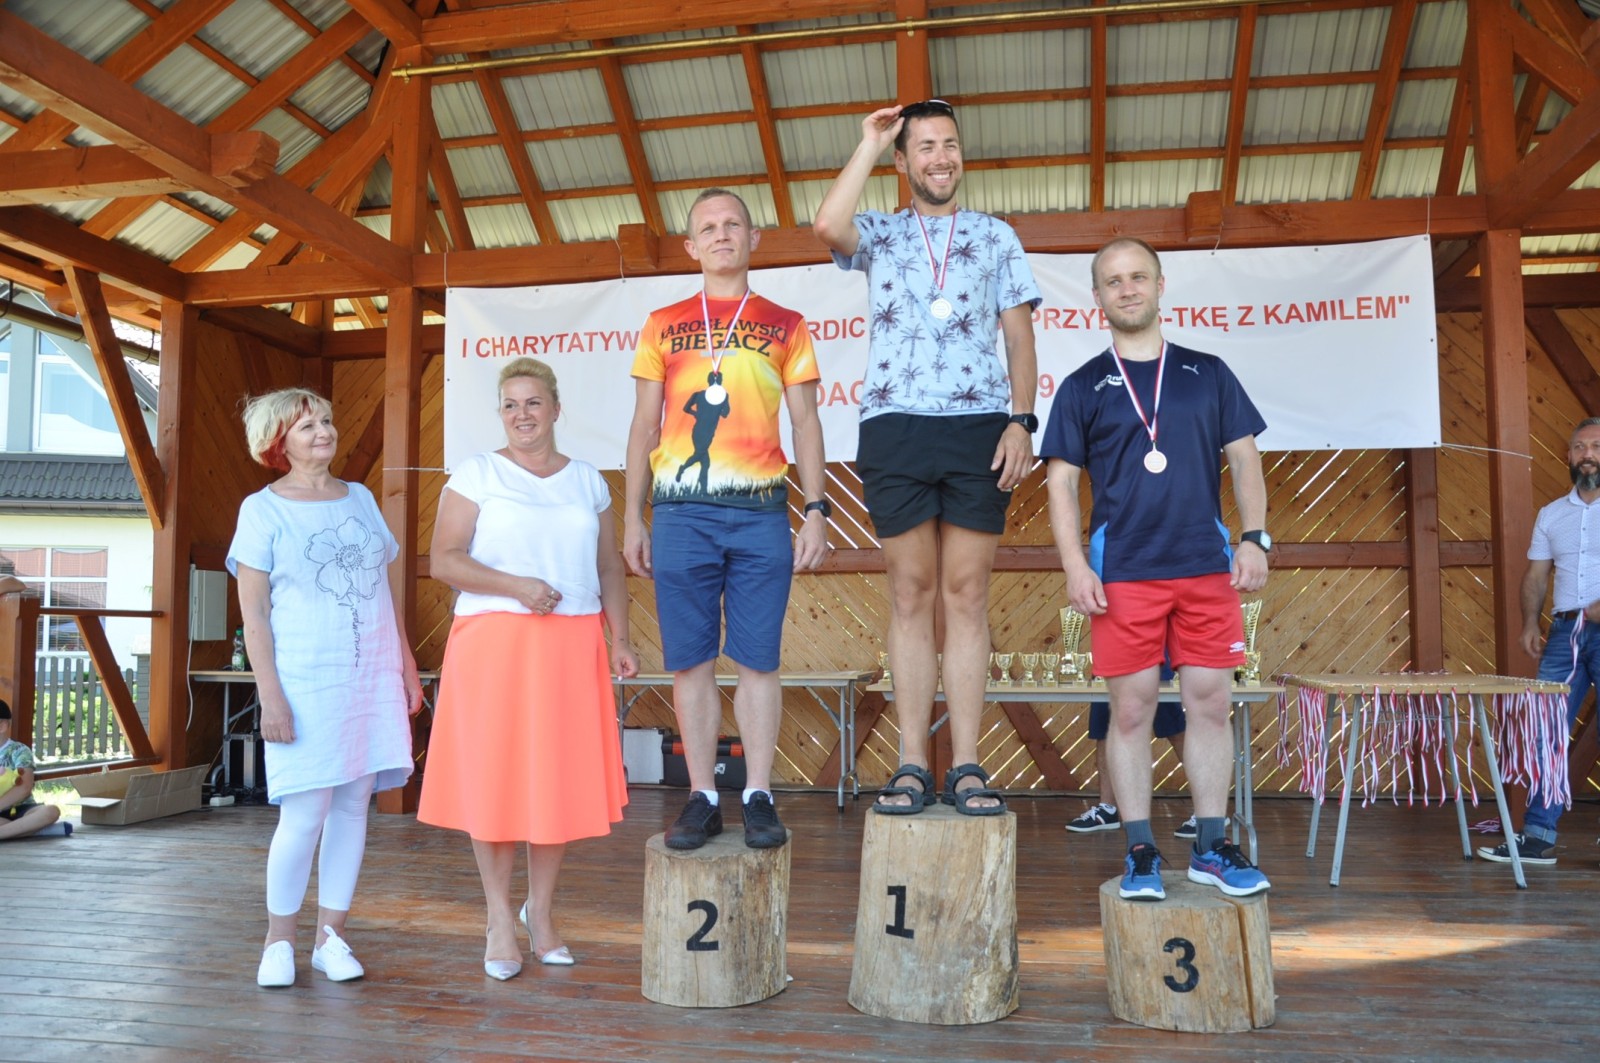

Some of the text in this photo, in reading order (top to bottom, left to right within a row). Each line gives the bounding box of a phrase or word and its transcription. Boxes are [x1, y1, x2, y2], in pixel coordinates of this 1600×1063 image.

[462, 338, 468, 358] I
[1237, 305, 1256, 326] Z
[1263, 295, 1410, 325] KAMILEM"
[670, 332, 773, 357] BIEGACZ
[686, 899, 719, 951] 2
[885, 885, 914, 940] 1
[1163, 937, 1199, 993] 3
